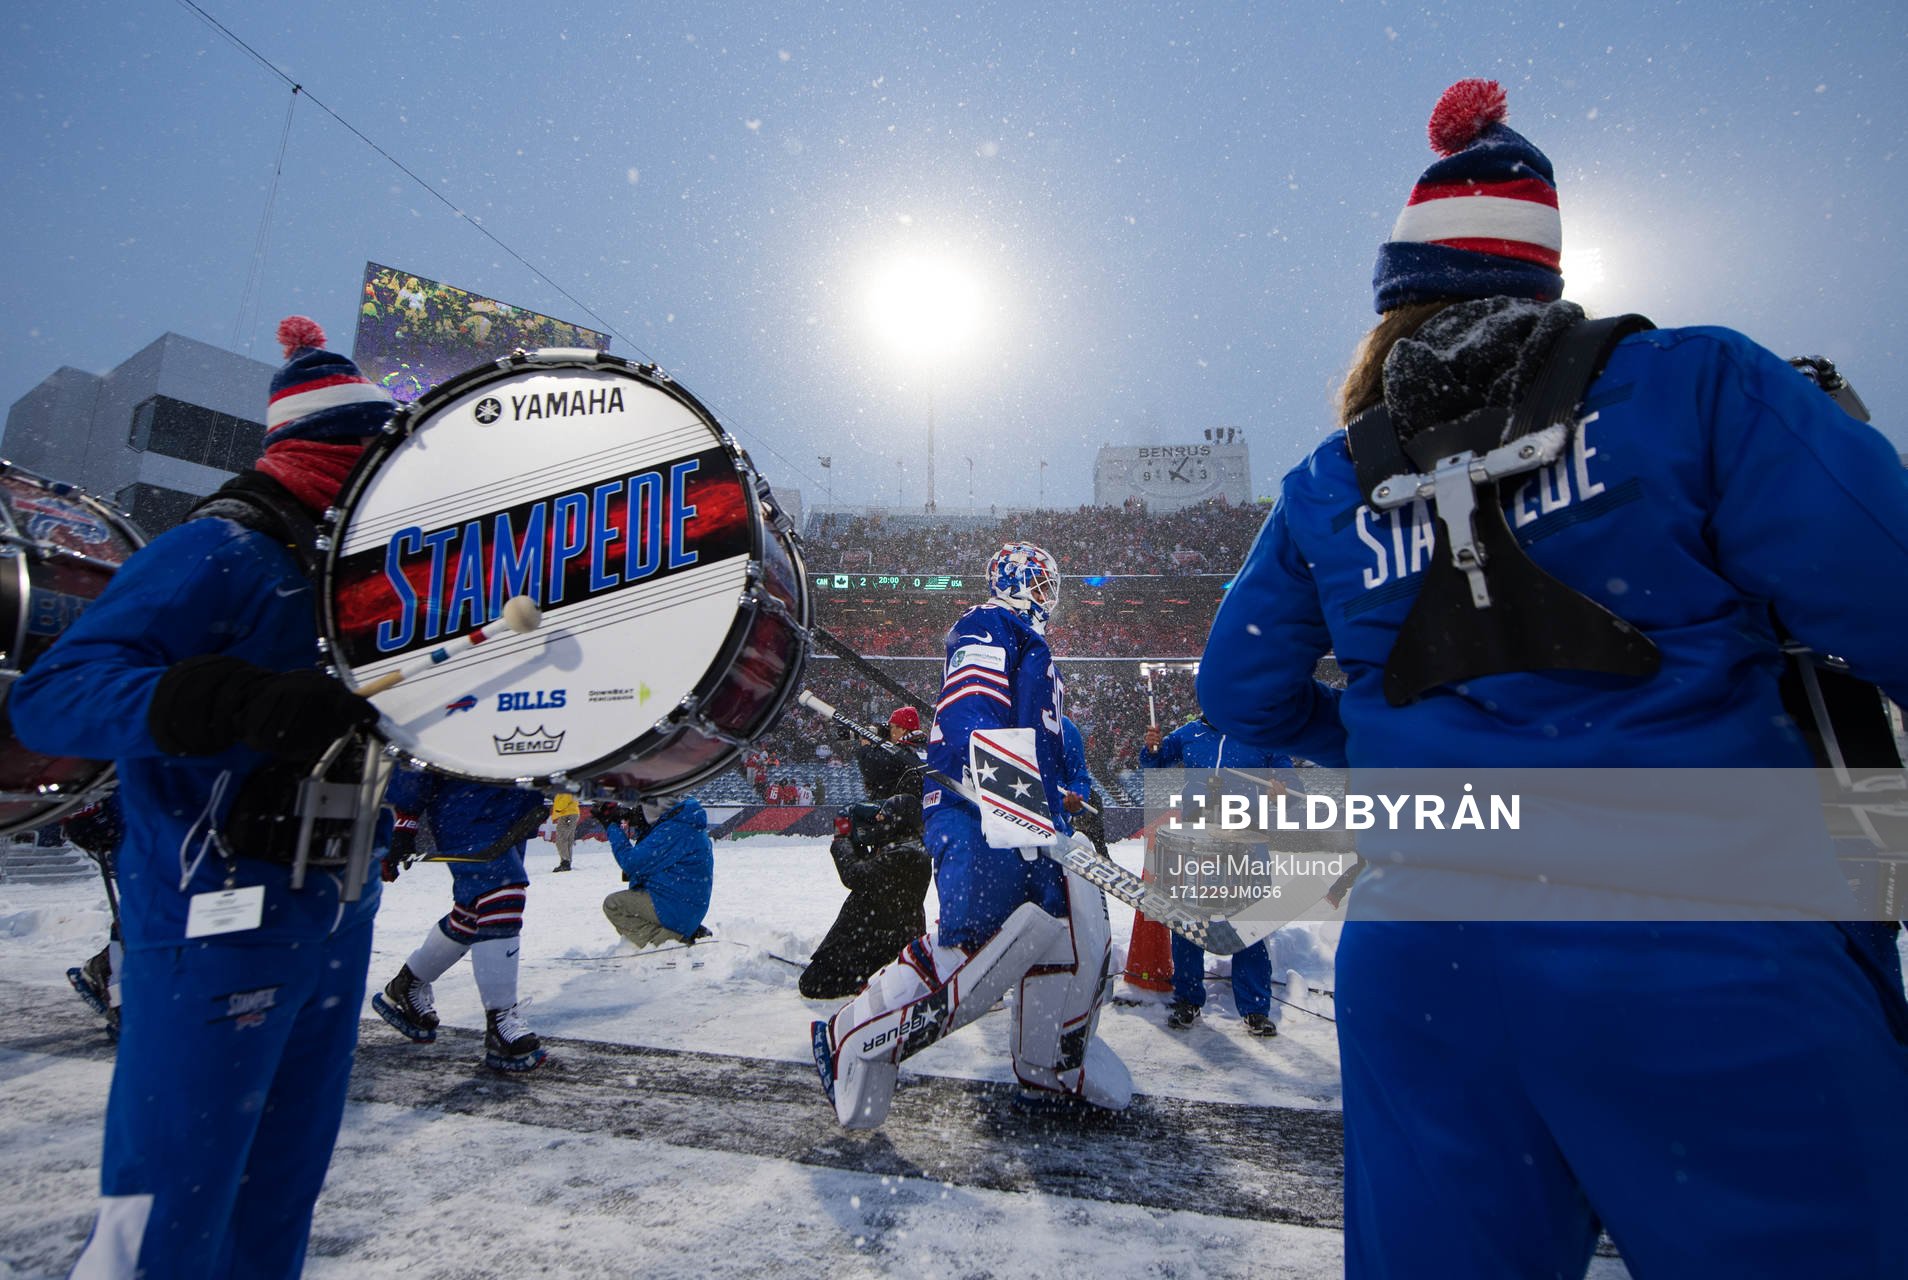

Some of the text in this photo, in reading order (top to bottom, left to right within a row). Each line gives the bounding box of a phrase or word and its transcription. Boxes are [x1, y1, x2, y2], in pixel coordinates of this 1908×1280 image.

[512, 387, 625, 421] YAMAHA
[1139, 446, 1210, 458] BENRUS
[1355, 410, 1606, 590] STADE
[376, 458, 701, 652] STAMPEDE
[860, 577, 867, 587] 2
[914, 577, 921, 588] 0
[951, 580, 963, 588] USA
[497, 689, 566, 711] BILLS
[833, 712, 883, 744] SUPREME
[503, 740, 555, 752] REMO
